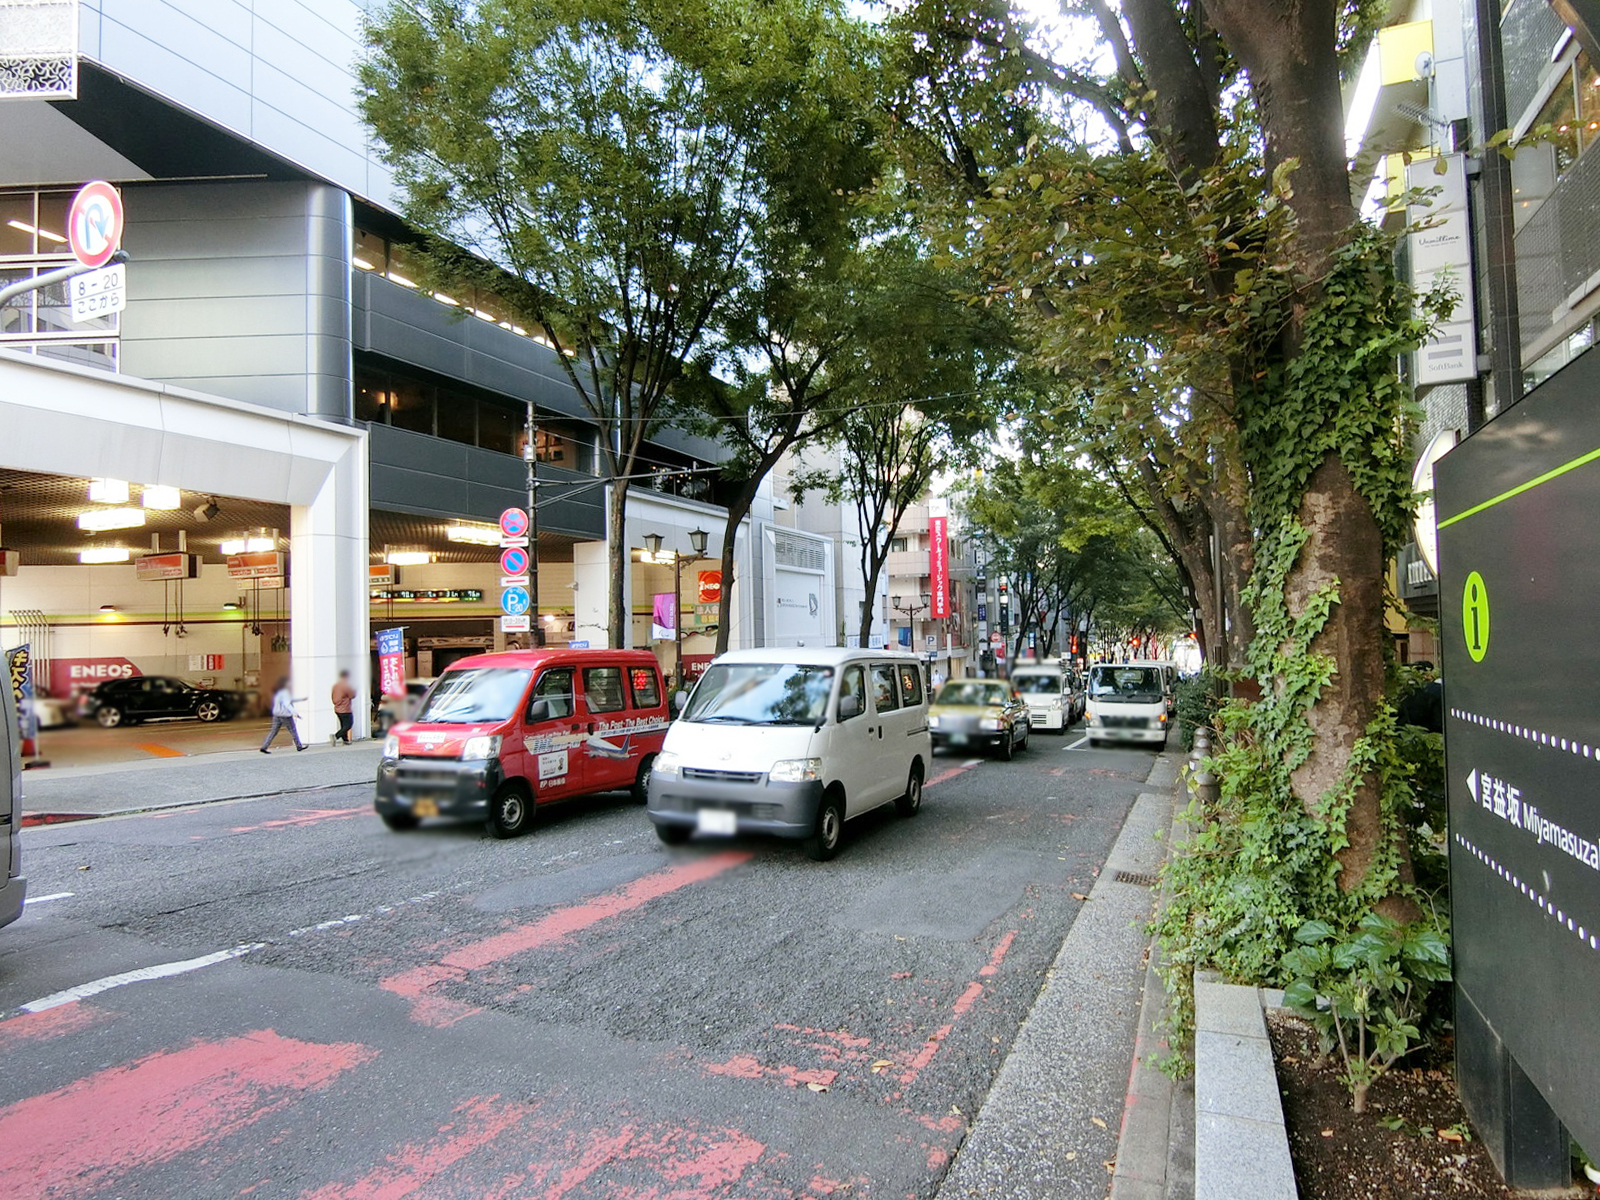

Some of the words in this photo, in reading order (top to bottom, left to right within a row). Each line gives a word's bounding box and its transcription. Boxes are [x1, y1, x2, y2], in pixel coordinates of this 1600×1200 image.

[78, 292, 119, 314] ここから
[1428, 361, 1464, 372] SoftBank
[508, 594, 519, 612] P
[927, 636, 935, 645] P
[70, 664, 133, 678] ENEOS
[1481, 772, 1521, 828] 宮益坂
